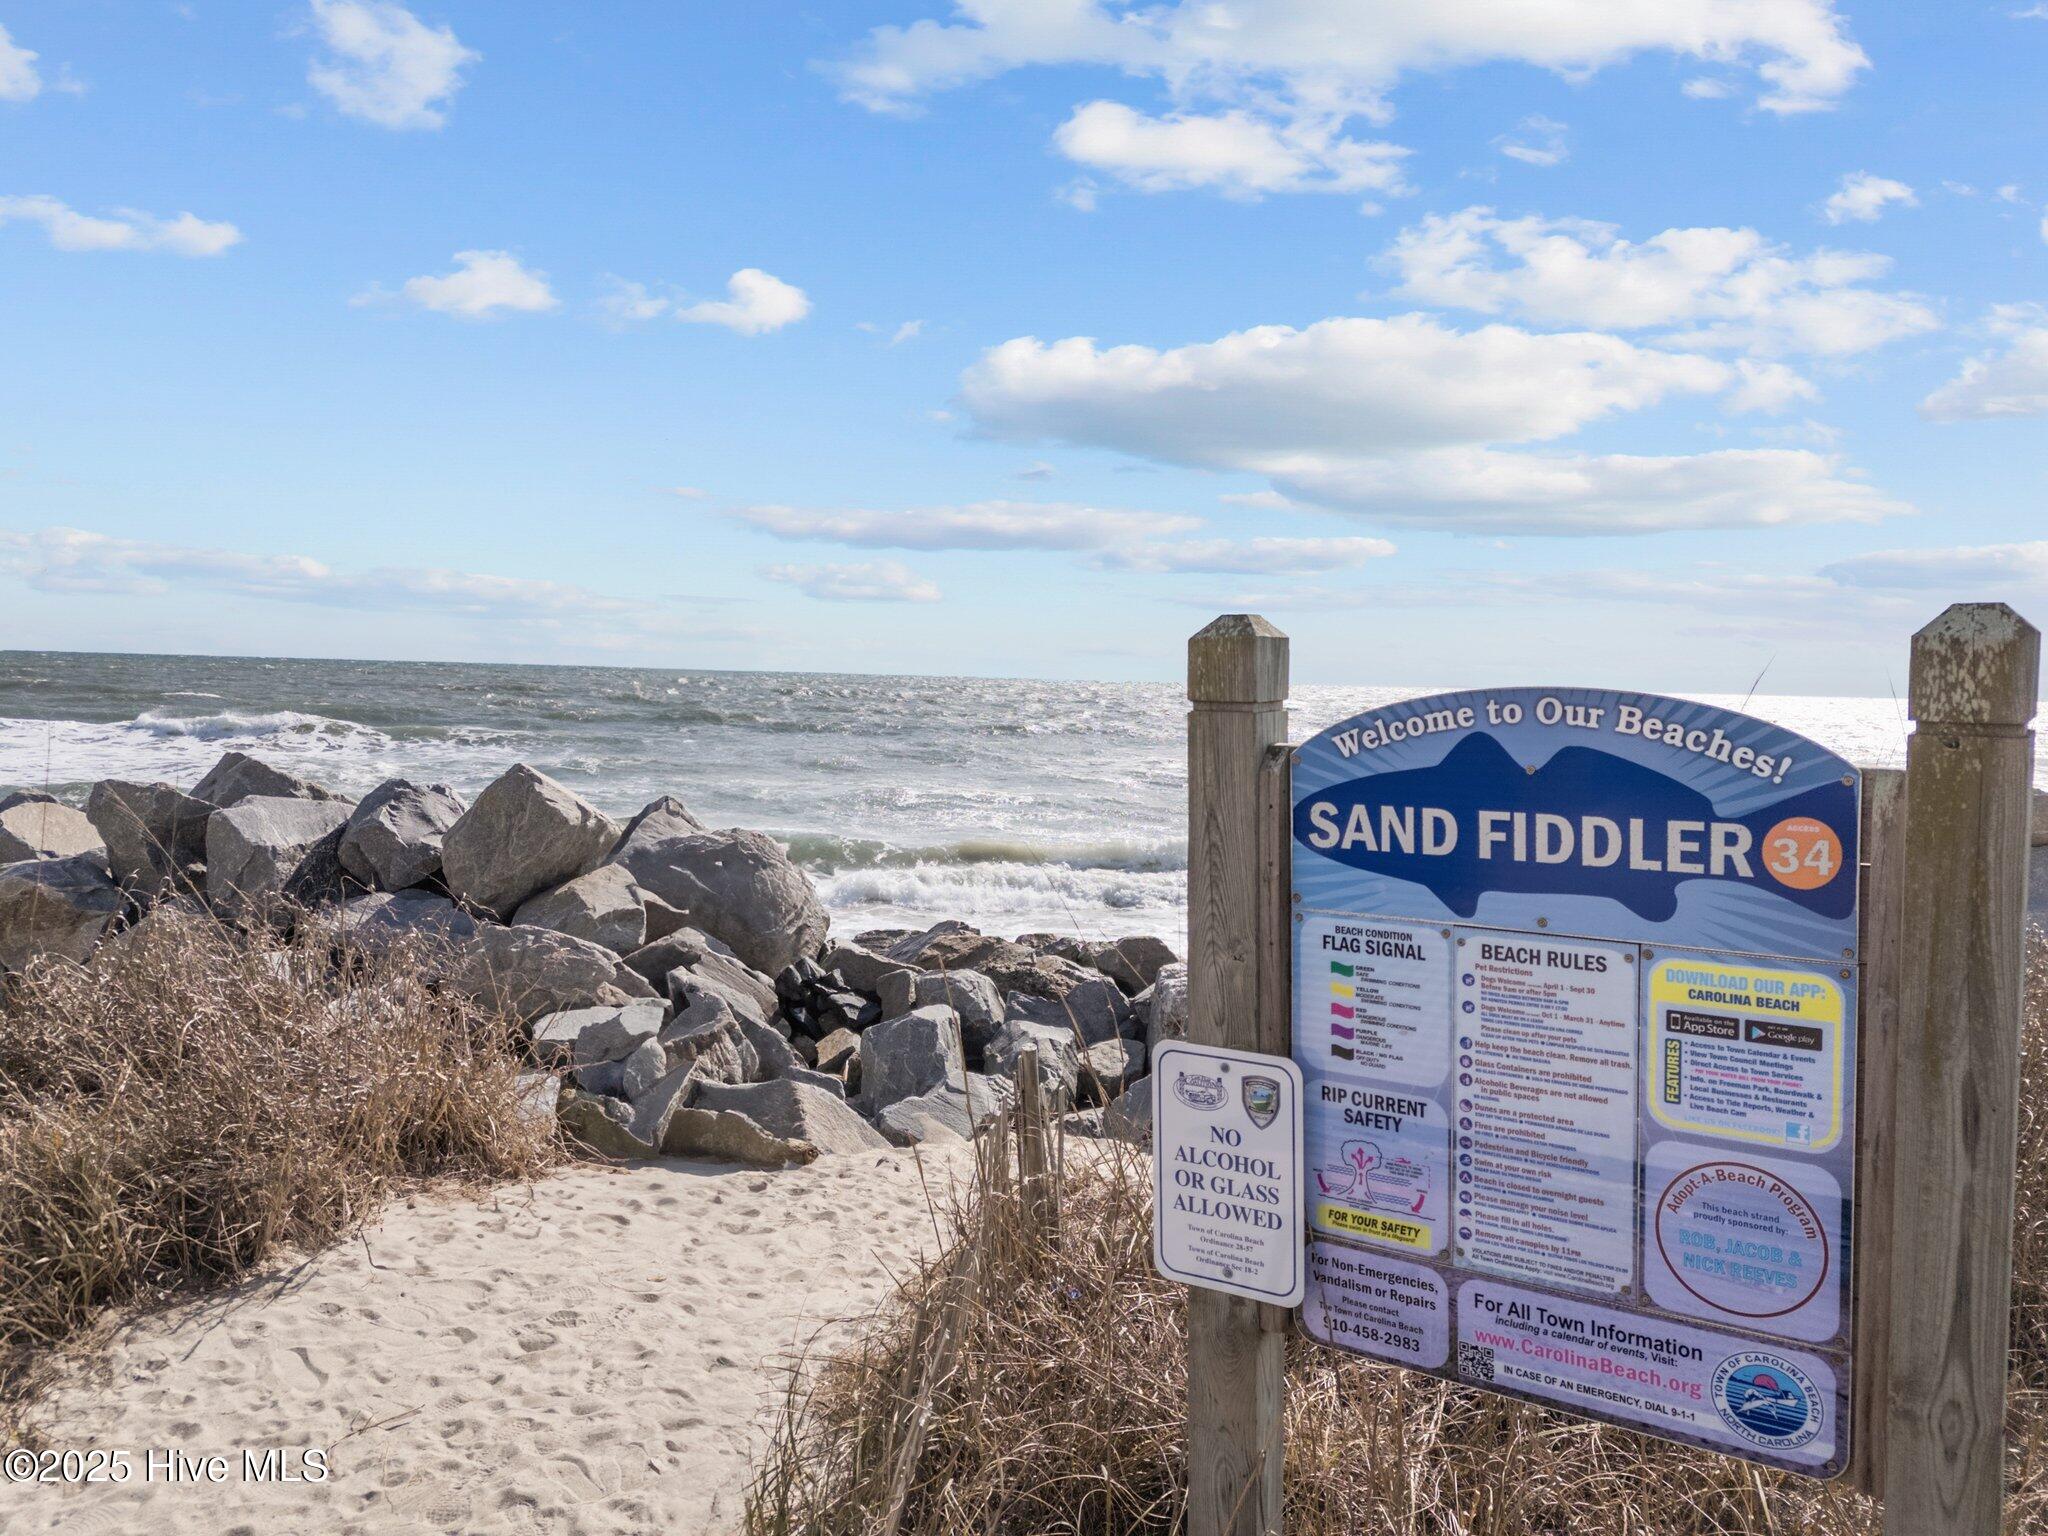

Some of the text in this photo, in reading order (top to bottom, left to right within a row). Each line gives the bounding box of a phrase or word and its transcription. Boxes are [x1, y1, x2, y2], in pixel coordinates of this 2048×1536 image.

[1332, 697, 1793, 785] Welcome to Our Beaches!
[1308, 801, 1755, 878] SAND FIDDLER
[1771, 838, 1834, 875] 34
[1323, 935, 1426, 961] FLAG SIGNAL
[1335, 926, 1412, 942] BEACH CONDITION
[1475, 963, 1533, 976] Pet Restrictions
[1481, 944, 1607, 972] BEACH RULES
[1666, 969, 1826, 999] DOWNLOAD OUR APP:
[1688, 989, 1800, 1012] CAROLINA BEACH
[1684, 1015, 1712, 1023] Available
[1724, 1019, 1735, 1027] the
[1684, 1021, 1735, 1036] App Store
[1690, 1041, 1715, 1051] Access
[1717, 1044, 1724, 1052] to
[1726, 1046, 1745, 1054] Town
[1748, 1048, 1780, 1059] Calendar
[1791, 1054, 1815, 1064] Events
[1768, 1031, 1815, 1046] Google play
[1475, 1041, 1490, 1050] Help
[1492, 1042, 1508, 1052] keep
[1523, 1046, 1544, 1056] beach
[1546, 1050, 1568, 1060] clean.
[1570, 1054, 1597, 1065] Remove
[1599, 1058, 1609, 1066] all
[1611, 1060, 1632, 1069] trash.
[1690, 1050, 1793, 1071] View Town Council Meetings
[1475, 1059, 1495, 1069] Glass
[1496, 1062, 1536, 1075] Containers
[1539, 1069, 1550, 1077] are
[1552, 1070, 1592, 1083] prohibited
[1667, 1040, 1680, 1102] FEATURES
[1322, 1086, 1427, 1118] RIP CURRENT
[1475, 1077, 1508, 1089] Alcoholic
[1564, 1091, 1576, 1099] not
[1578, 1093, 1608, 1105] allowed
[1481, 1086, 1488, 1094] in
[1490, 1088, 1512, 1098] public
[1514, 1092, 1539, 1102] spaces
[1690, 1085, 1709, 1094] Local
[1711, 1087, 1752, 1100] Businesses
[1762, 1095, 1807, 1108] Restaurants
[1344, 1108, 1402, 1132] SAFETY
[1475, 1103, 1497, 1113] Dunes
[1519, 1111, 1555, 1124] protected
[1557, 1118, 1574, 1126] area
[1210, 1126, 1241, 1147] NO
[1475, 1121, 1492, 1132] Fires
[1507, 1128, 1545, 1140] prohibited
[1175, 1145, 1281, 1180] ALCOHOL
[1475, 1140, 1514, 1153] Pedestrian
[1515, 1148, 1529, 1157] and
[1531, 1150, 1557, 1162] Bicycle
[1560, 1155, 1588, 1168] friendly
[1175, 1169, 1280, 1205] OR GLASS
[1474, 1175, 1497, 1186] Beach
[1499, 1179, 1505, 1187] is
[1507, 1181, 1531, 1192] closed
[1542, 1189, 1576, 1202] overnight
[1579, 1196, 1604, 1206] guests
[1173, 1194, 1282, 1230] ALLOWED
[1667, 1169, 1817, 1239] Adopt-A-Beach Program
[1702, 1202, 1780, 1224] This beach strand
[1188, 1224, 1205, 1234] Town
[1215, 1230, 1243, 1242] Carolina
[1245, 1236, 1264, 1246] Beach
[1328, 1209, 1420, 1237] FOR YOUR SAFETY
[1694, 1211, 1789, 1236] proudly sponsored by:
[1200, 1236, 1233, 1250] Ordinance
[1679, 1229, 1802, 1267] ROB, JACOB &
[1311, 1252, 1438, 1295] For Non-Emergencies,
[1683, 1252, 1797, 1289] NICK REEVES
[1313, 1270, 1436, 1311] Vandalism or Repairs
[1334, 1303, 1352, 1317] Town
[1354, 1310, 1362, 1319] of
[1364, 1313, 1396, 1328] Carolina
[1399, 1322, 1423, 1335] Beach
[1342, 1296, 1400, 1317] Please contact
[1474, 1293, 1703, 1361] For All Town Information
[1495, 1315, 1540, 1336] including
[1551, 1330, 1595, 1347] calendar
[1597, 1341, 1608, 1350] of
[1611, 1345, 1647, 1361] events,
[1651, 1353, 1678, 1367] Visit:
[1474, 1330, 1702, 1400] www.CarolinaBeach.org
[1504, 1365, 1696, 1421] IN CASE OF AN EMERGENCY, DIAL 9-1-1
[1715, 1355, 1820, 1423] TOWN OF CAROLINA BEACH
[1720, 1408, 1814, 1447] NORTH CAROLINA
